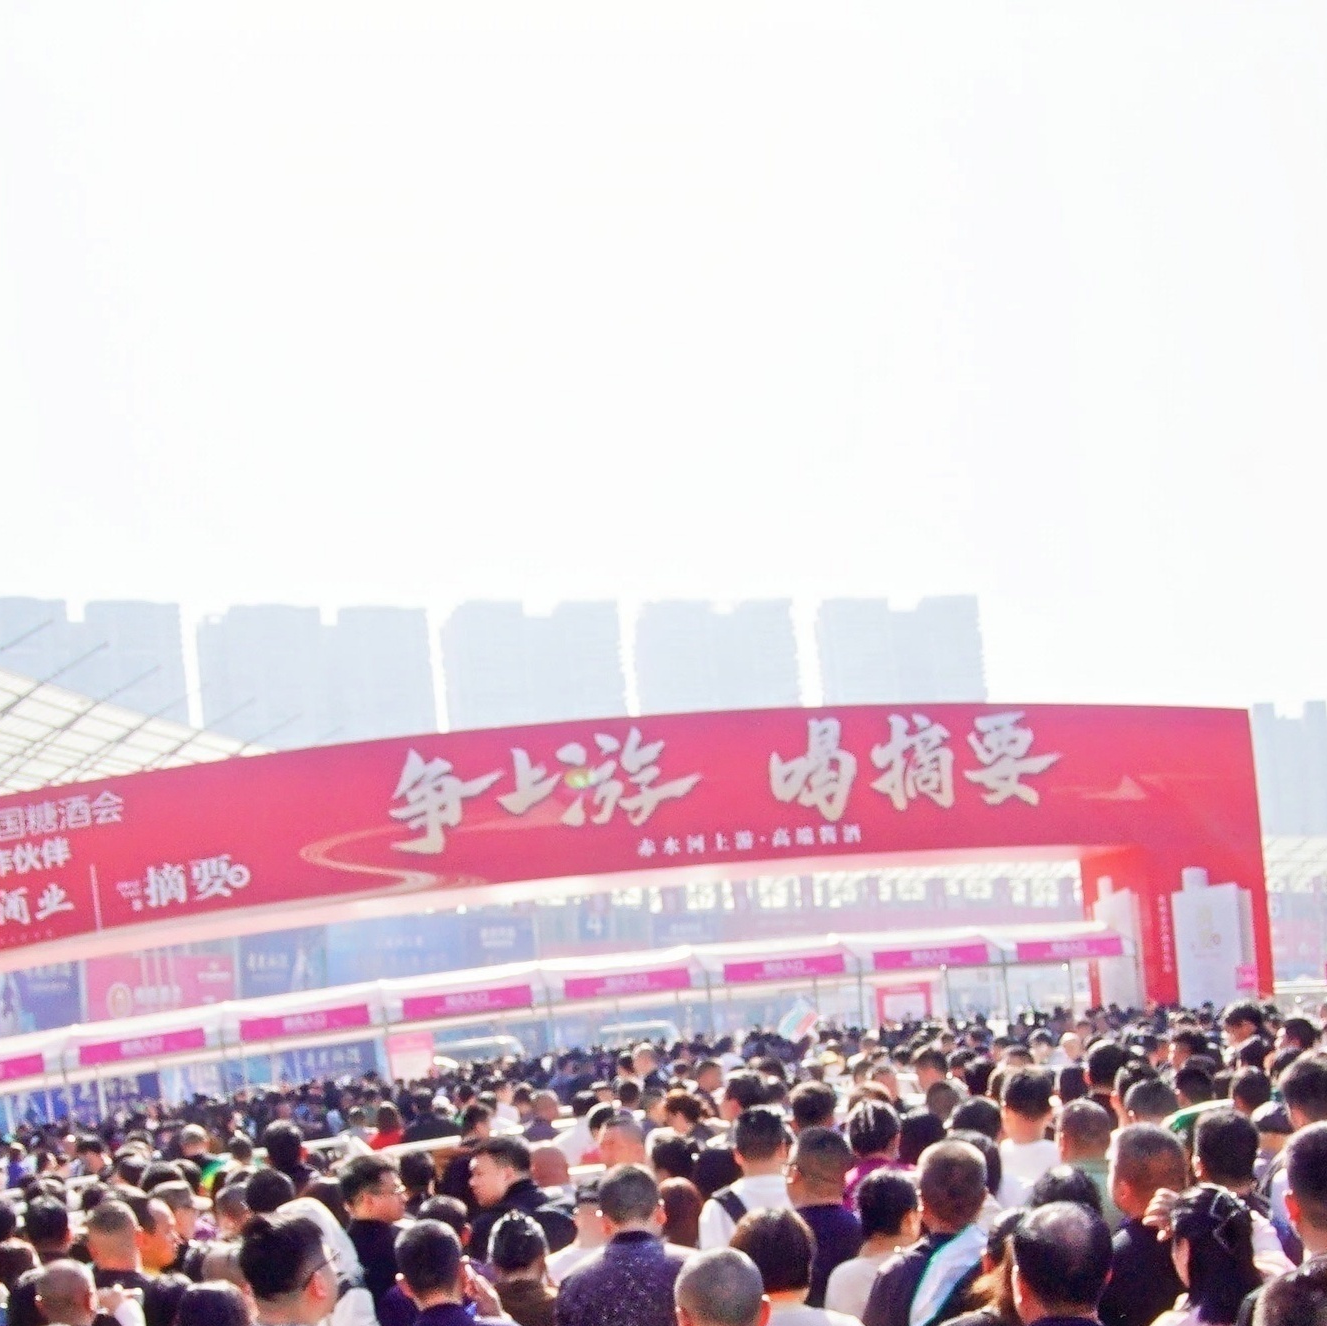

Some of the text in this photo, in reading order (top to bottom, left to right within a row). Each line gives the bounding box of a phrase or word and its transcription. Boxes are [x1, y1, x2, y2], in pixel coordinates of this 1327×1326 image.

[389, 710, 1063, 855] 争上游 喝摘要
[144, 853, 233, 908] 摘要
